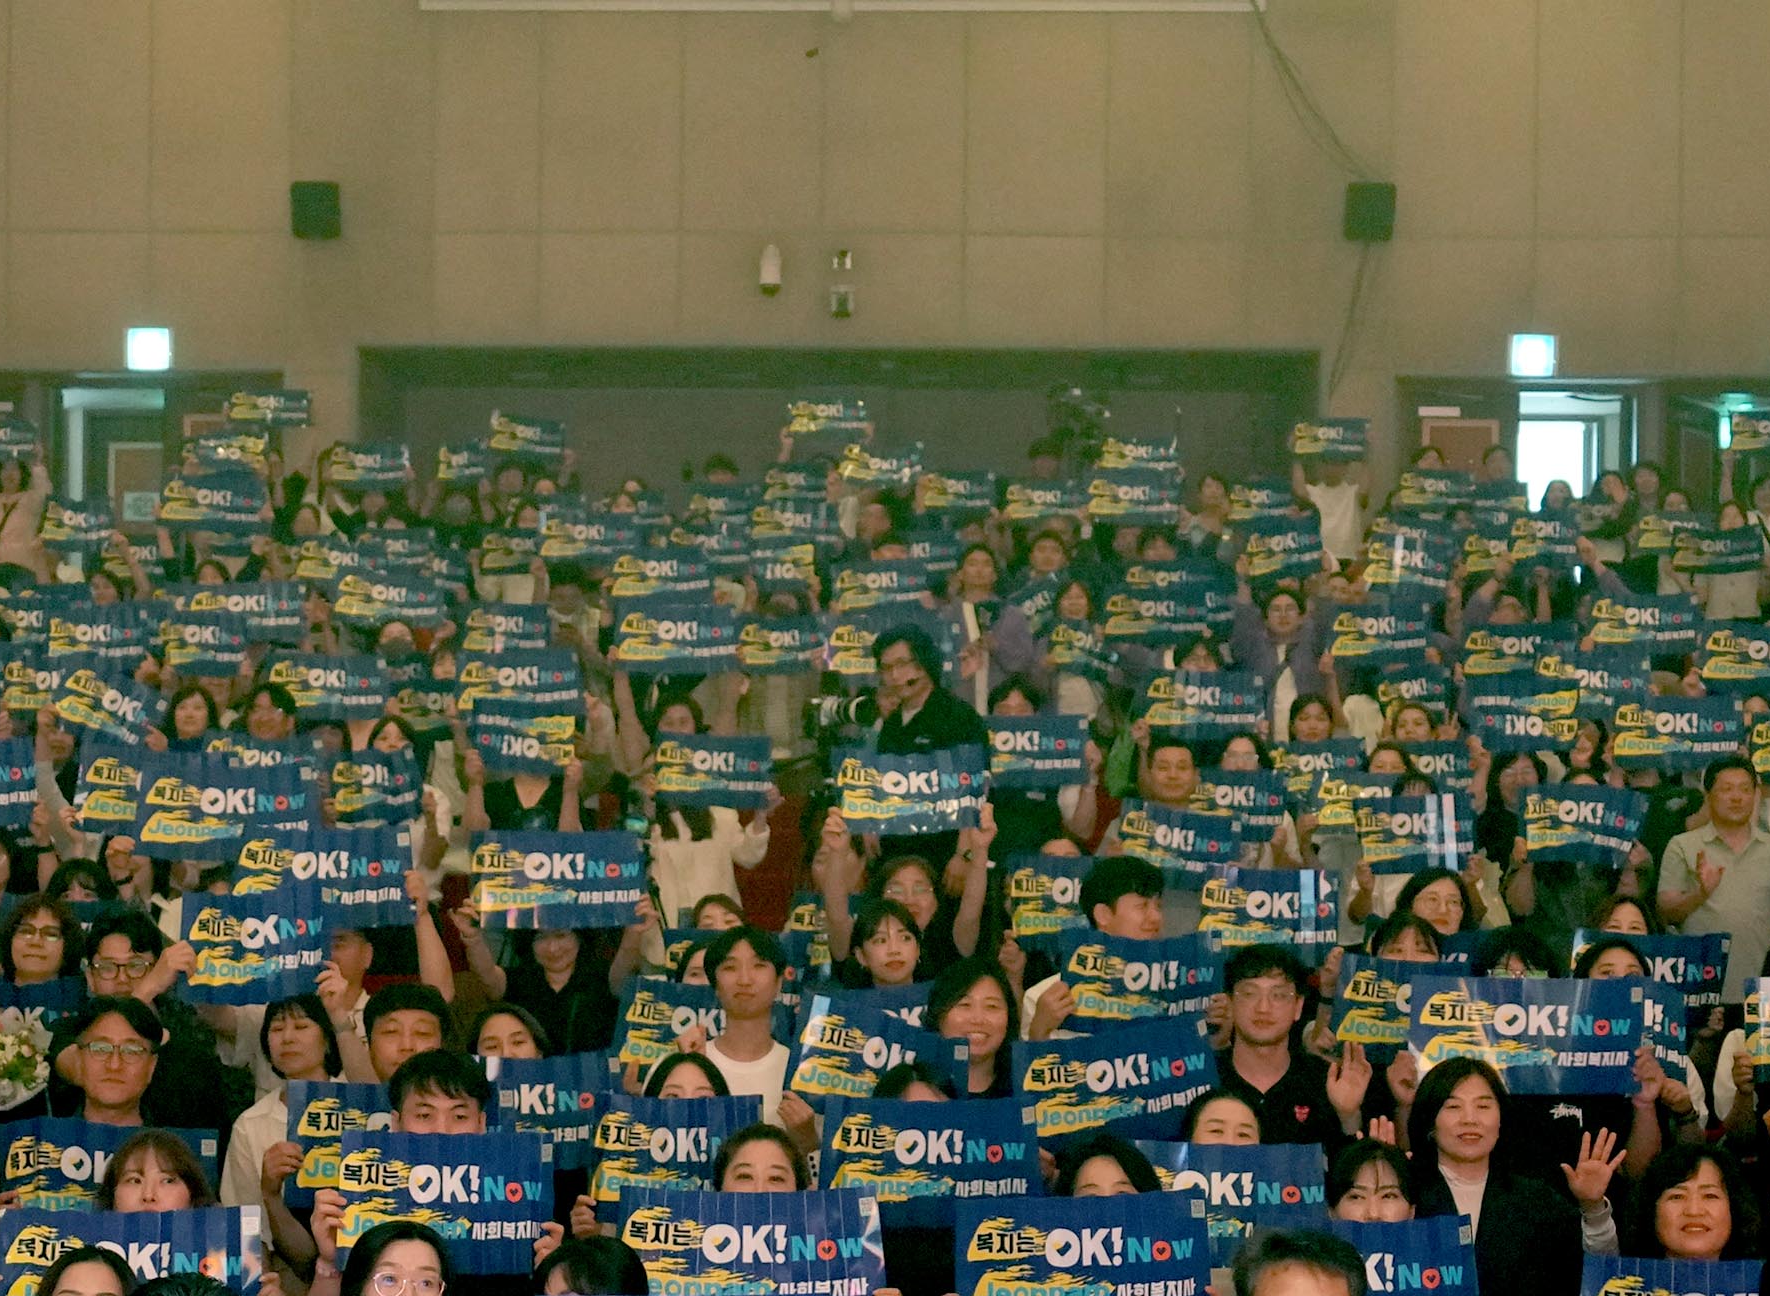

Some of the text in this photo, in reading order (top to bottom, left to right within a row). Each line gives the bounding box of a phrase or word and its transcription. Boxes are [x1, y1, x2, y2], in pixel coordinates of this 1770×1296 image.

[657, 621, 697, 640] OK!
[497, 666, 538, 686] OK!
[1182, 683, 1220, 706] OK!
[290, 851, 349, 880] OK!
[521, 853, 584, 880] OK!
[587, 858, 639, 880] Now
[1491, 1004, 1569, 1037] OK!
[1575, 1014, 1631, 1036] Now
[977, 1227, 1192, 1267] 복지는 OK! Now
